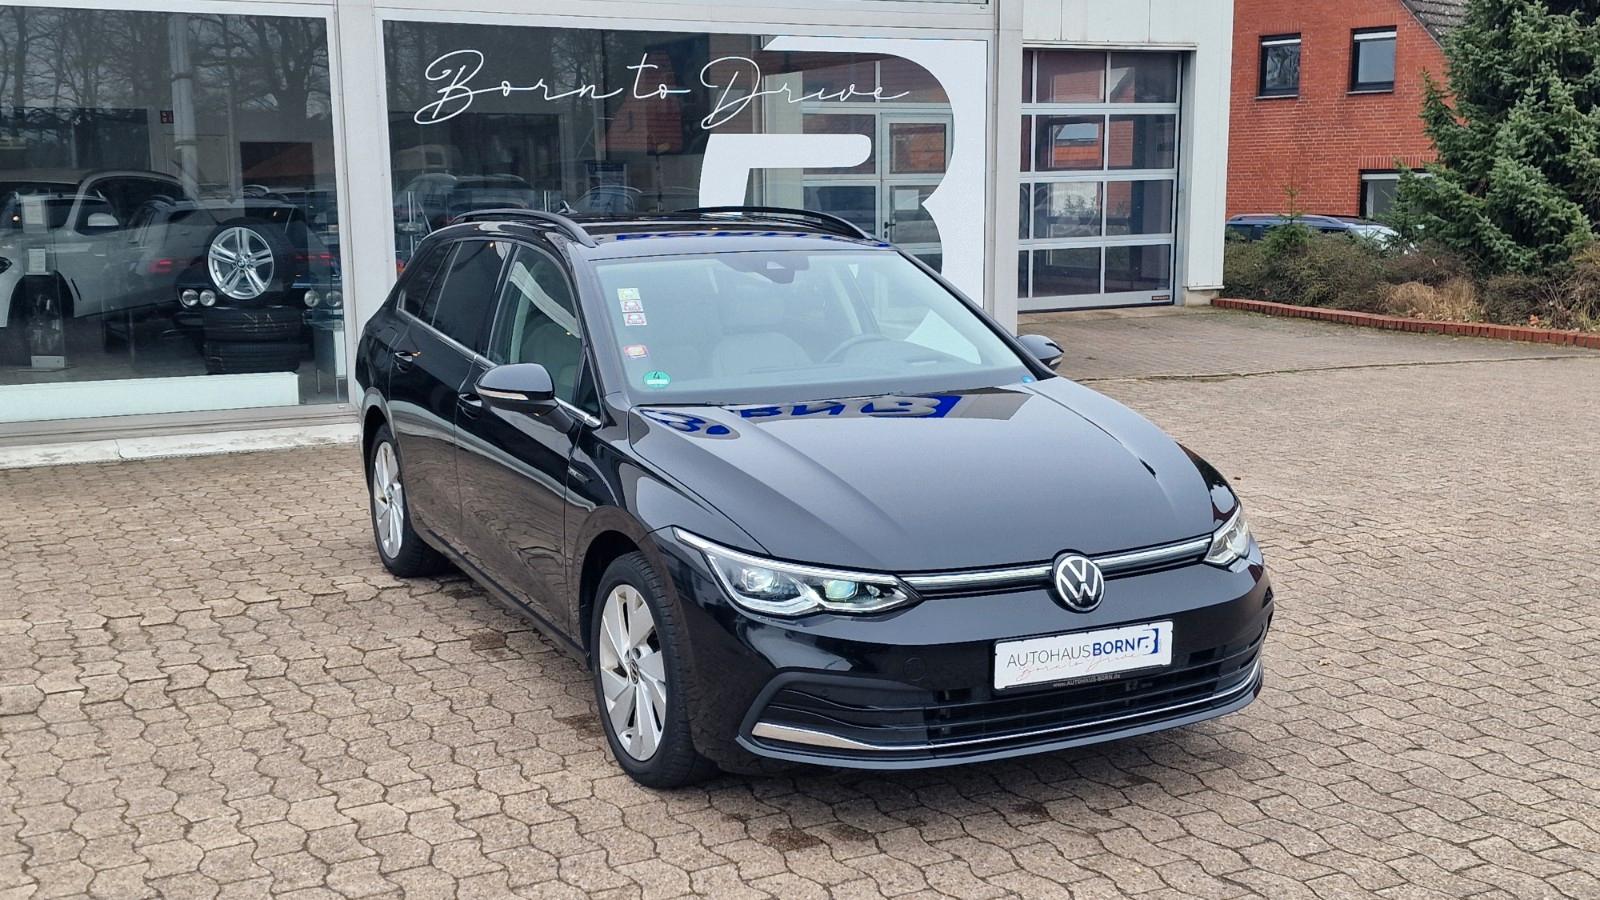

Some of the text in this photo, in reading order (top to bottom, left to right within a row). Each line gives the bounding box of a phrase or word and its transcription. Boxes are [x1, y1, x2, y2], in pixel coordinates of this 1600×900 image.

[414, 49, 910, 129] Born to Drive
[1057, 557, 1102, 607] VW
